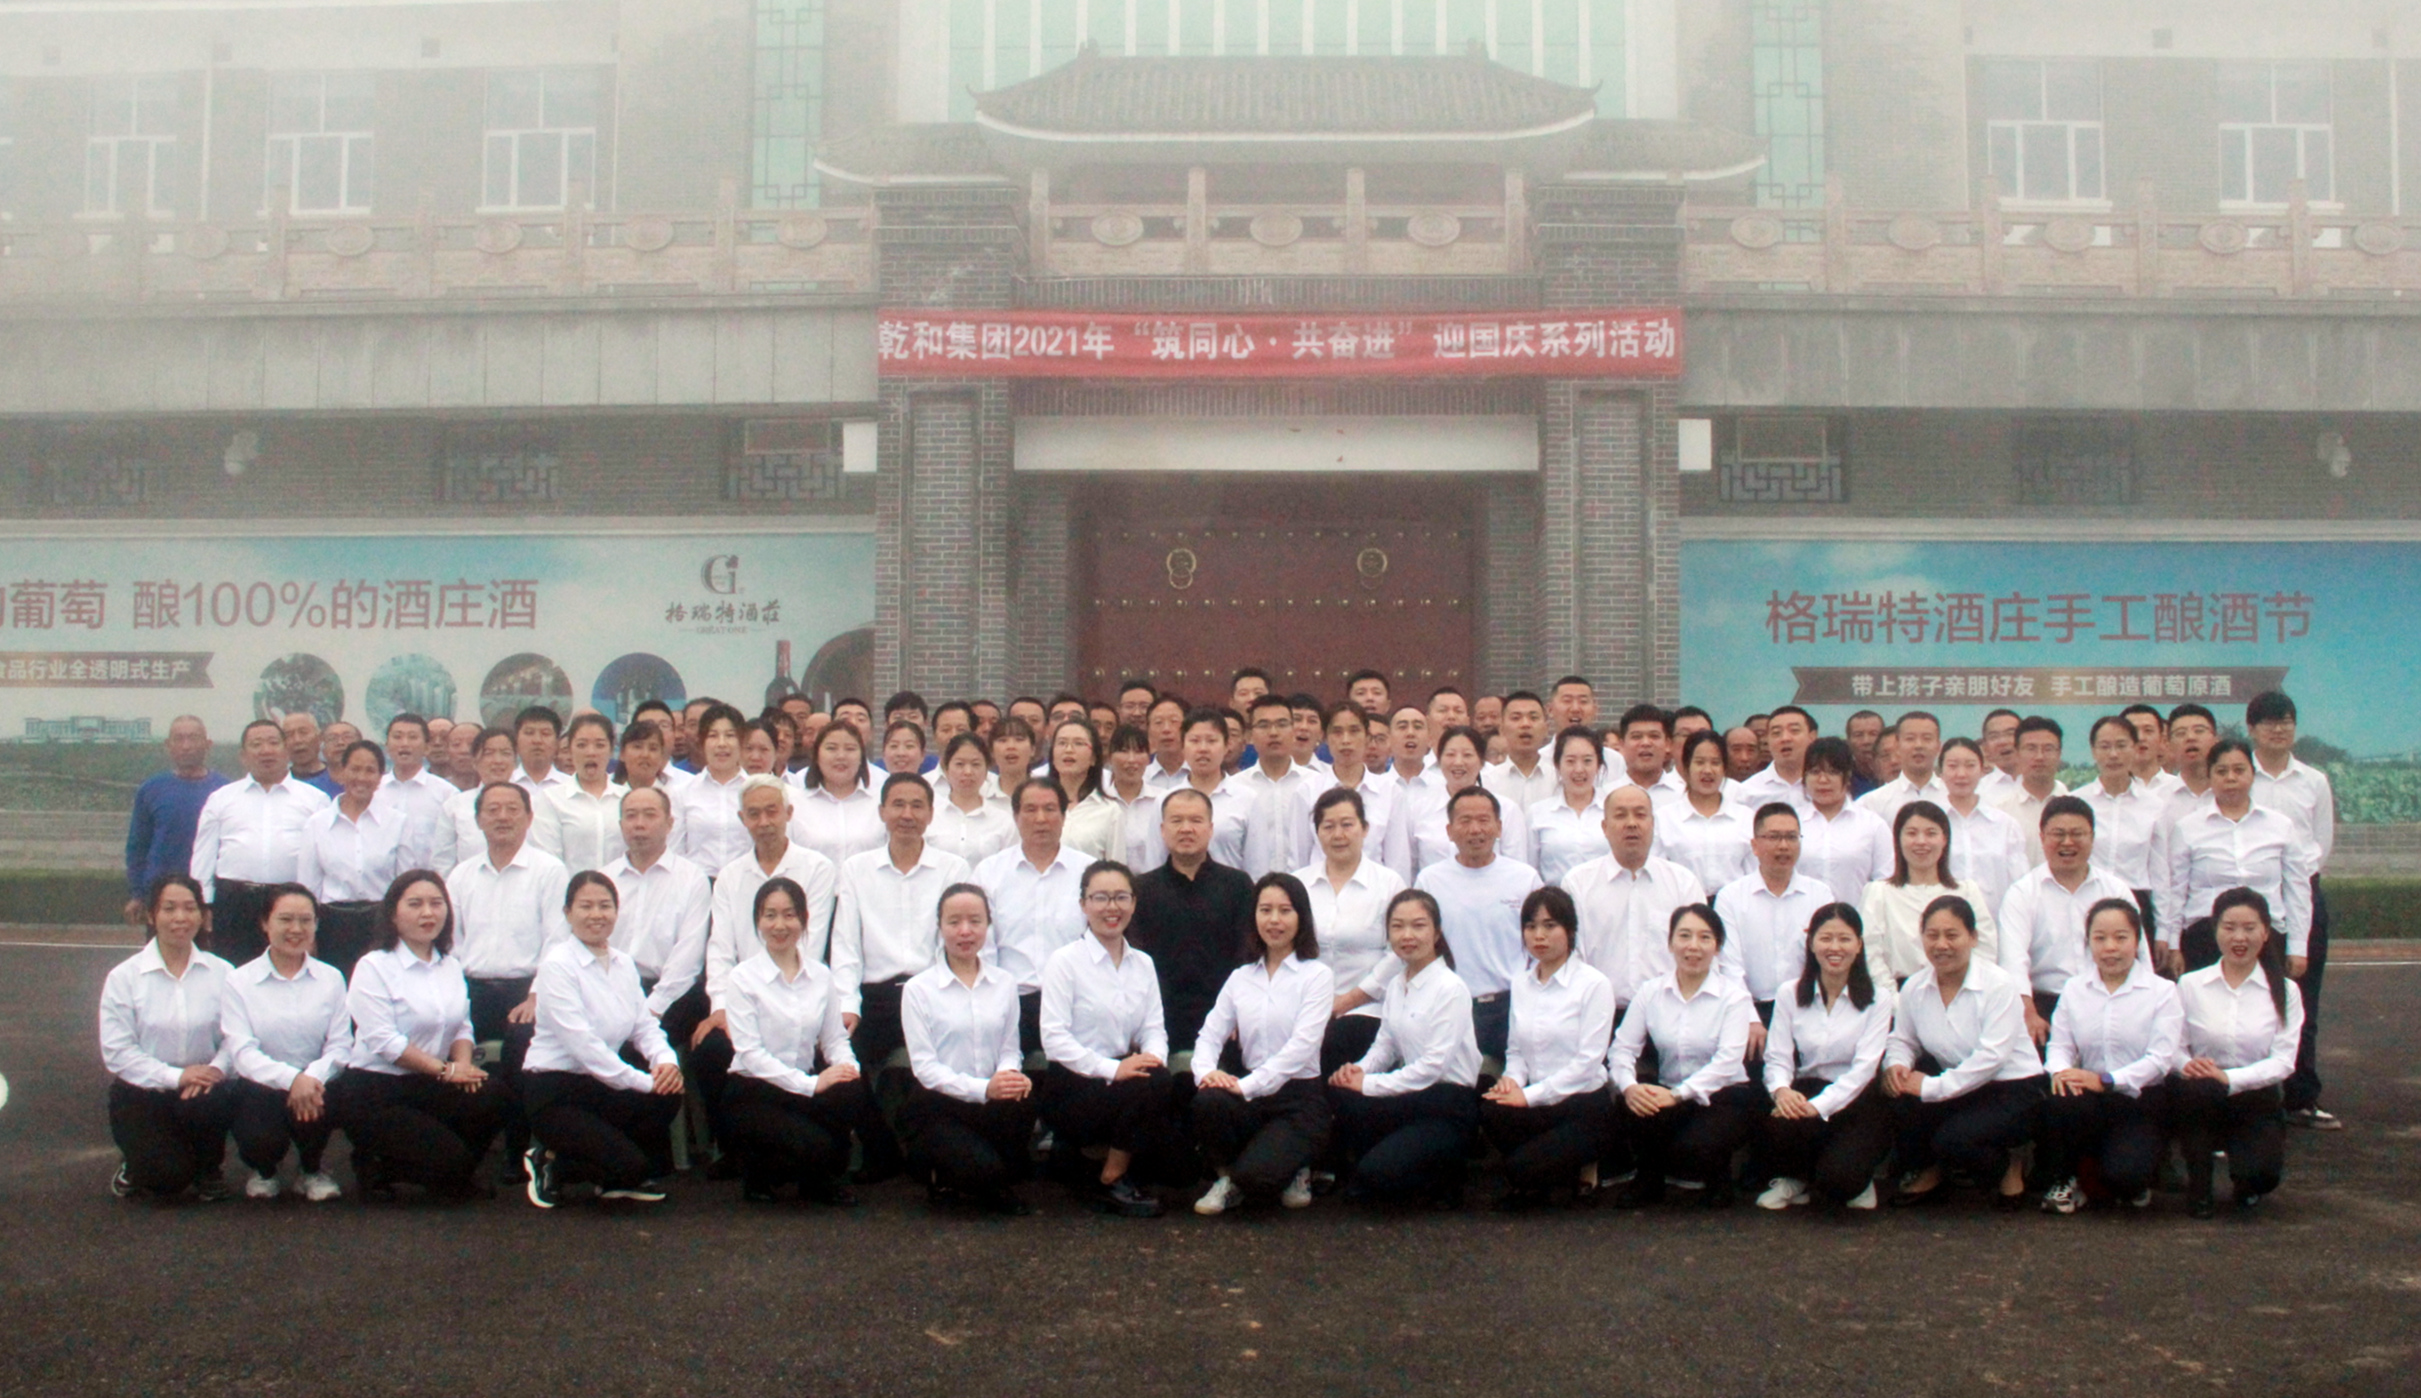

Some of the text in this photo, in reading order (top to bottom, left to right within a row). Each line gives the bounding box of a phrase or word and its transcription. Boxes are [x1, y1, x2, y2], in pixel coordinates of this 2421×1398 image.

[878, 320, 1115, 360] 乾和集团2021年
[1433, 317, 1675, 359] 迎国庆系列活动
[0, 578, 539, 630] 葡萄 酿100%的酒庄酒
[1765, 590, 2313, 644] 格瑞特酒庄手工酿酒节
[0, 658, 191, 680] 品行业全透明式生产
[1852, 674, 2232, 697] 带上孩子亲朋好友 手工酿造葡萄原酒
